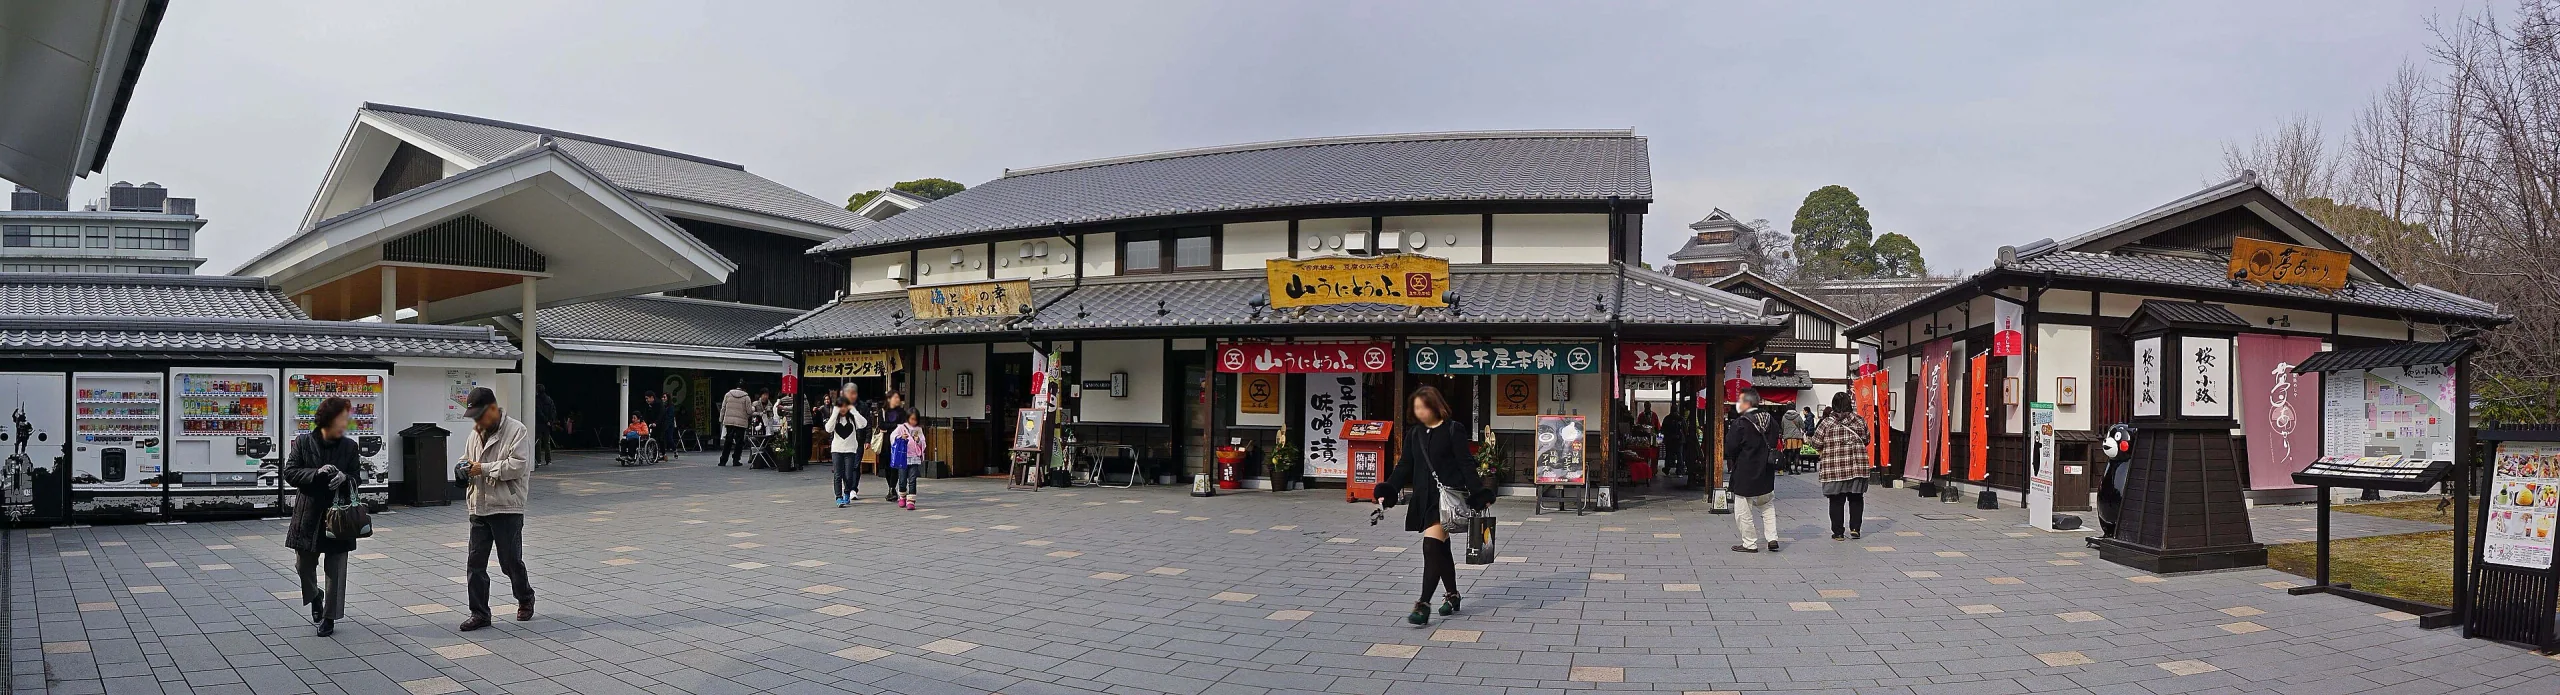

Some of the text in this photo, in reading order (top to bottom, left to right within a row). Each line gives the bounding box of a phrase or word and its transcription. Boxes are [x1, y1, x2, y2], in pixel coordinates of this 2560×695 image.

[2272, 247, 2329, 282] 夢あかり
[930, 283, 1007, 306] 海と山の幸
[1285, 273, 1401, 299] 山うにとうふ
[1254, 348, 1355, 371] 山うにとうふ
[1449, 348, 1557, 370] 五木屋本舗
[1633, 350, 1696, 371] 五木村
[2142, 348, 2155, 405] 桜の小路
[2194, 346, 2218, 405] 桜の小路
[1309, 392, 1338, 464] 味噌漬
